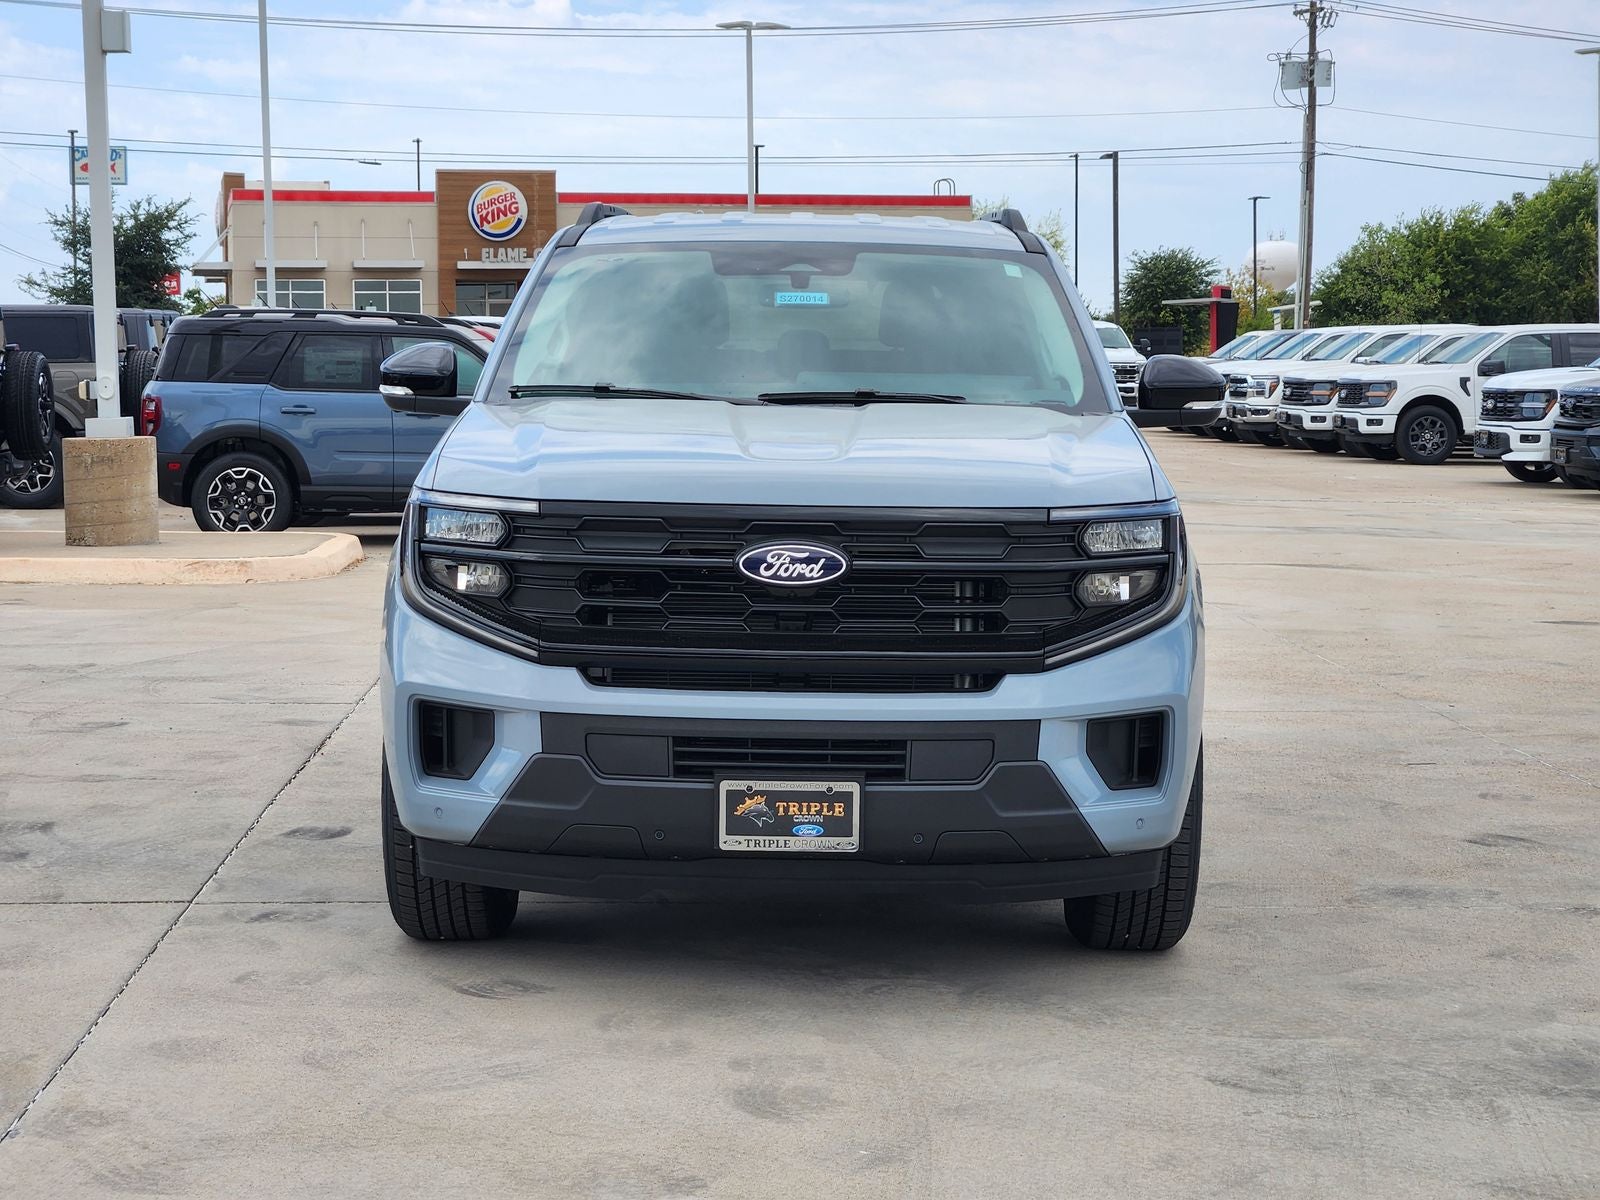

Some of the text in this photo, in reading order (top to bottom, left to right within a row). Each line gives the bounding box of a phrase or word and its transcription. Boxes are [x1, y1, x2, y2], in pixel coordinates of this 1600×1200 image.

[476, 191, 517, 215] BURGER
[479, 201, 520, 229] KING
[481, 247, 528, 262] FLAME
[779, 295, 824, 303] S270014
[759, 550, 826, 578] Ford
[727, 782, 854, 790] wwwTripleCrownFordcom
[775, 802, 845, 817] TRIPLE
[793, 815, 824, 823] CROWN
[798, 825, 818, 835] Ford
[744, 838, 791, 849] TRIPLE
[793, 839, 835, 850] CROWN
